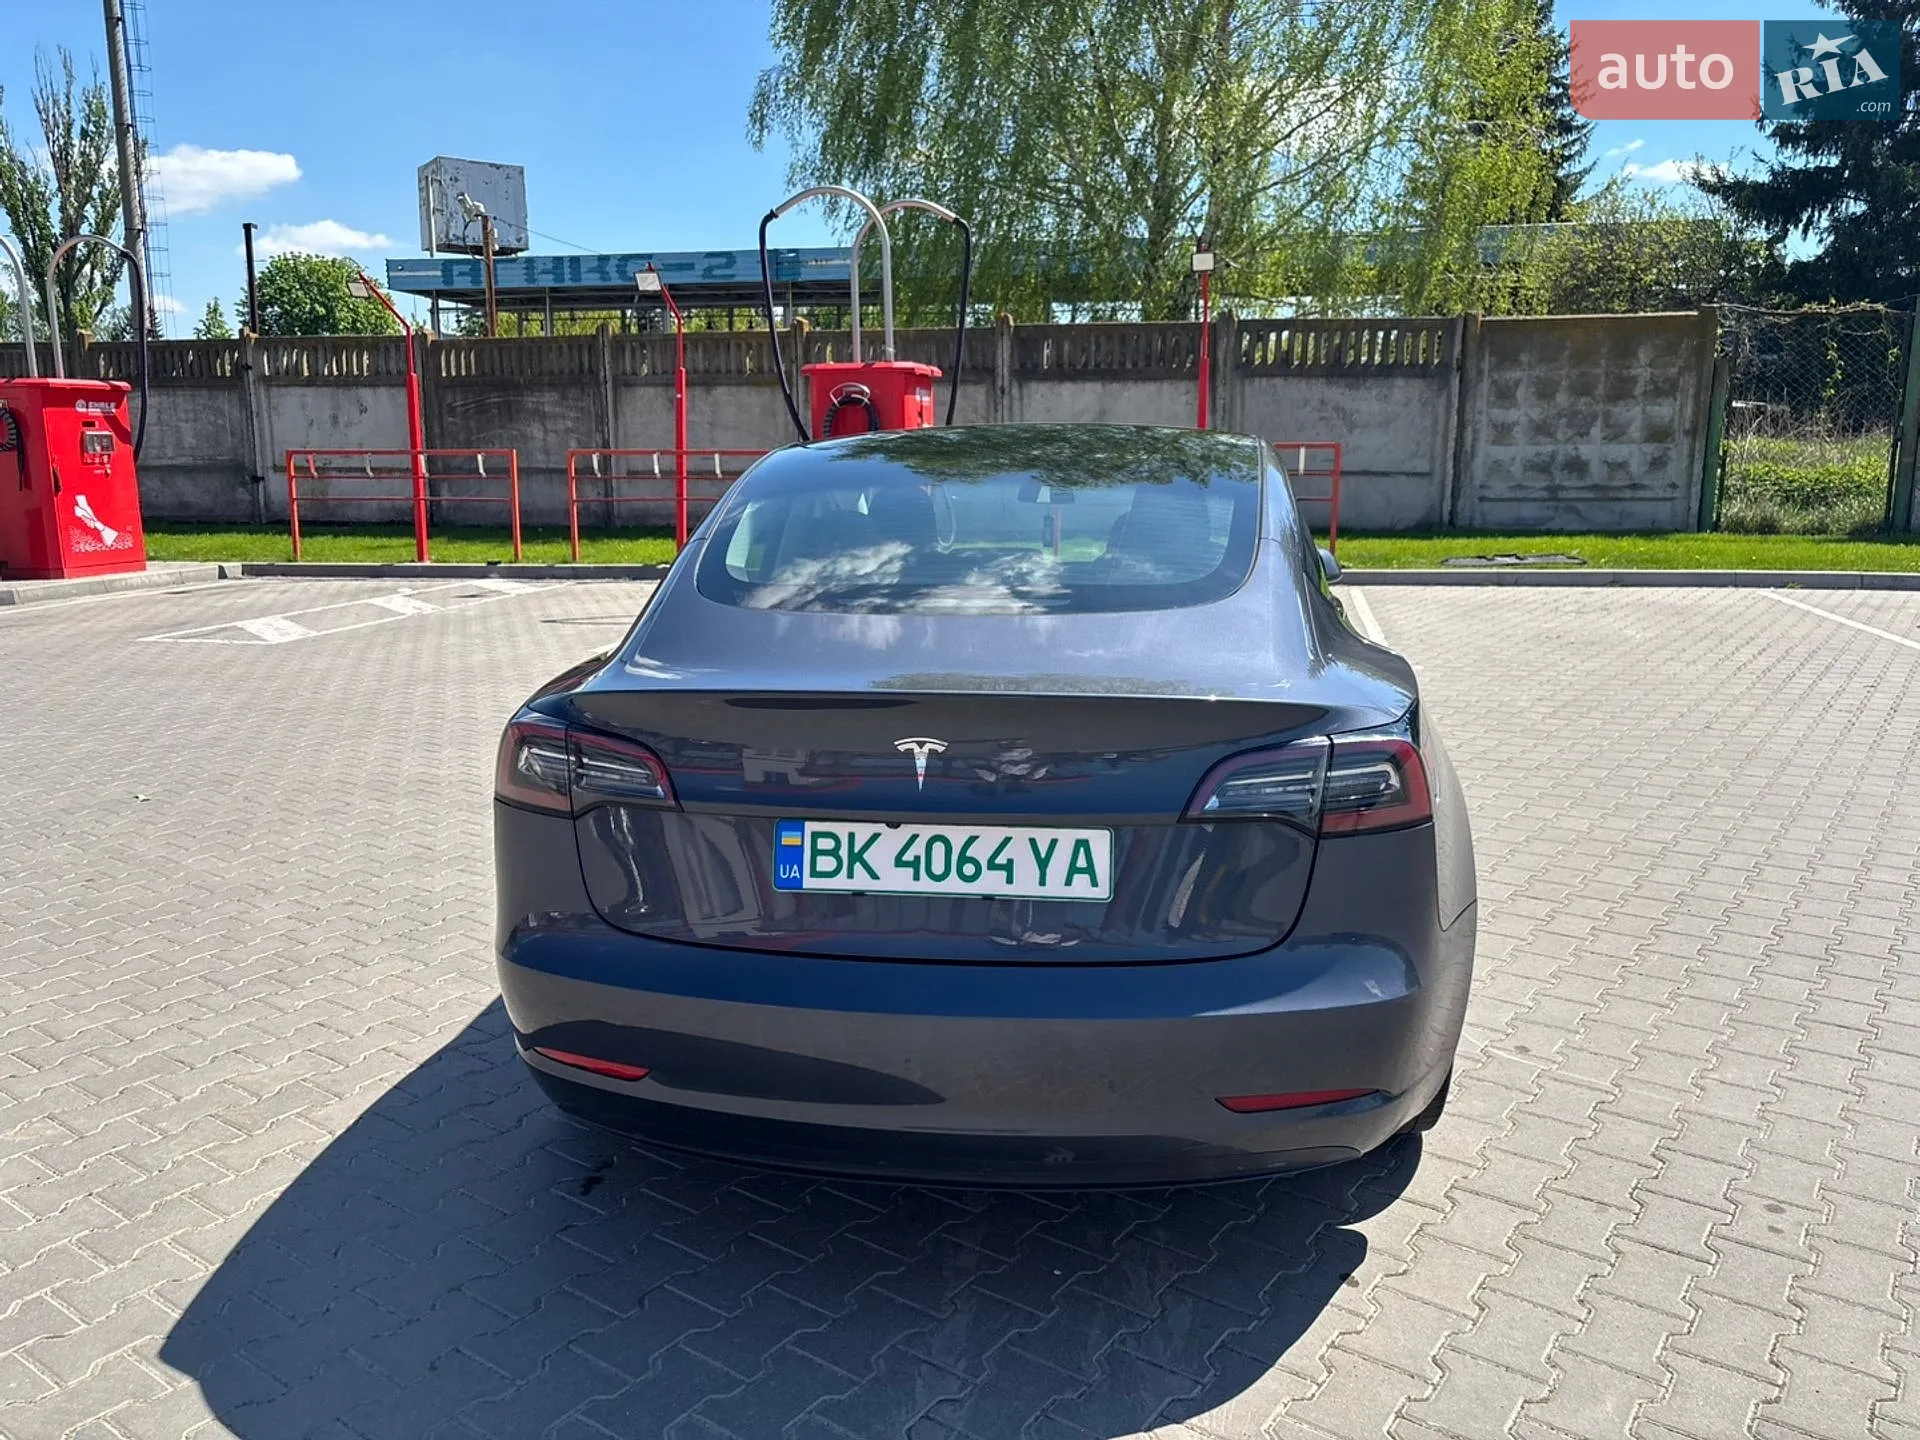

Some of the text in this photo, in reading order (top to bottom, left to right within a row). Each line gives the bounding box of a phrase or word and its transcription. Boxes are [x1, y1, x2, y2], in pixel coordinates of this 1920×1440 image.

[780, 831, 1099, 888] UA BK 4064 YA
